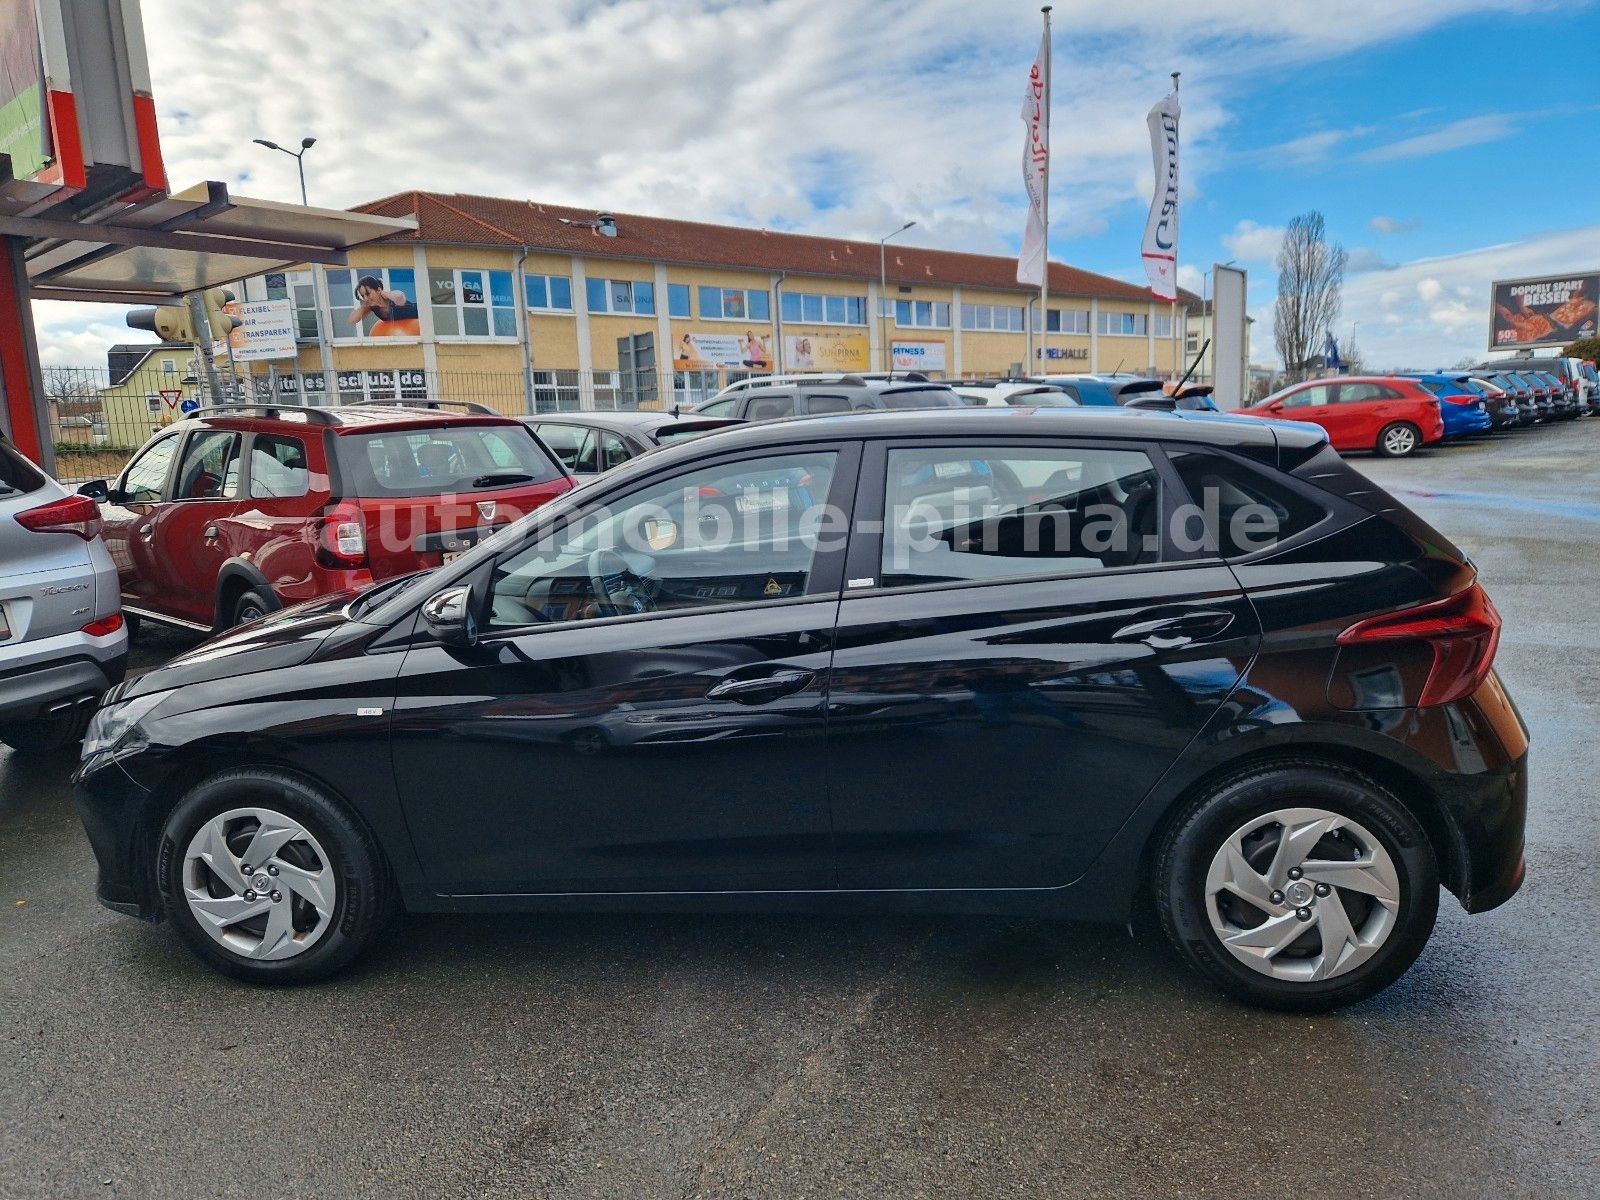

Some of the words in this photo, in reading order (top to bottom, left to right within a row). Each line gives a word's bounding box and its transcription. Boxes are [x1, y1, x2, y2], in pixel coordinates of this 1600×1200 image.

[436, 281, 482, 291] YOGA
[1511, 284, 1551, 296] DOPPELT
[1553, 280, 1584, 291] SPART
[470, 294, 512, 302] ZUMBA
[1524, 291, 1571, 306] BESSER
[240, 306, 271, 314] FLEXIBEL
[243, 328, 291, 338] TRANSPARENT
[893, 347, 925, 356] FITNESS
